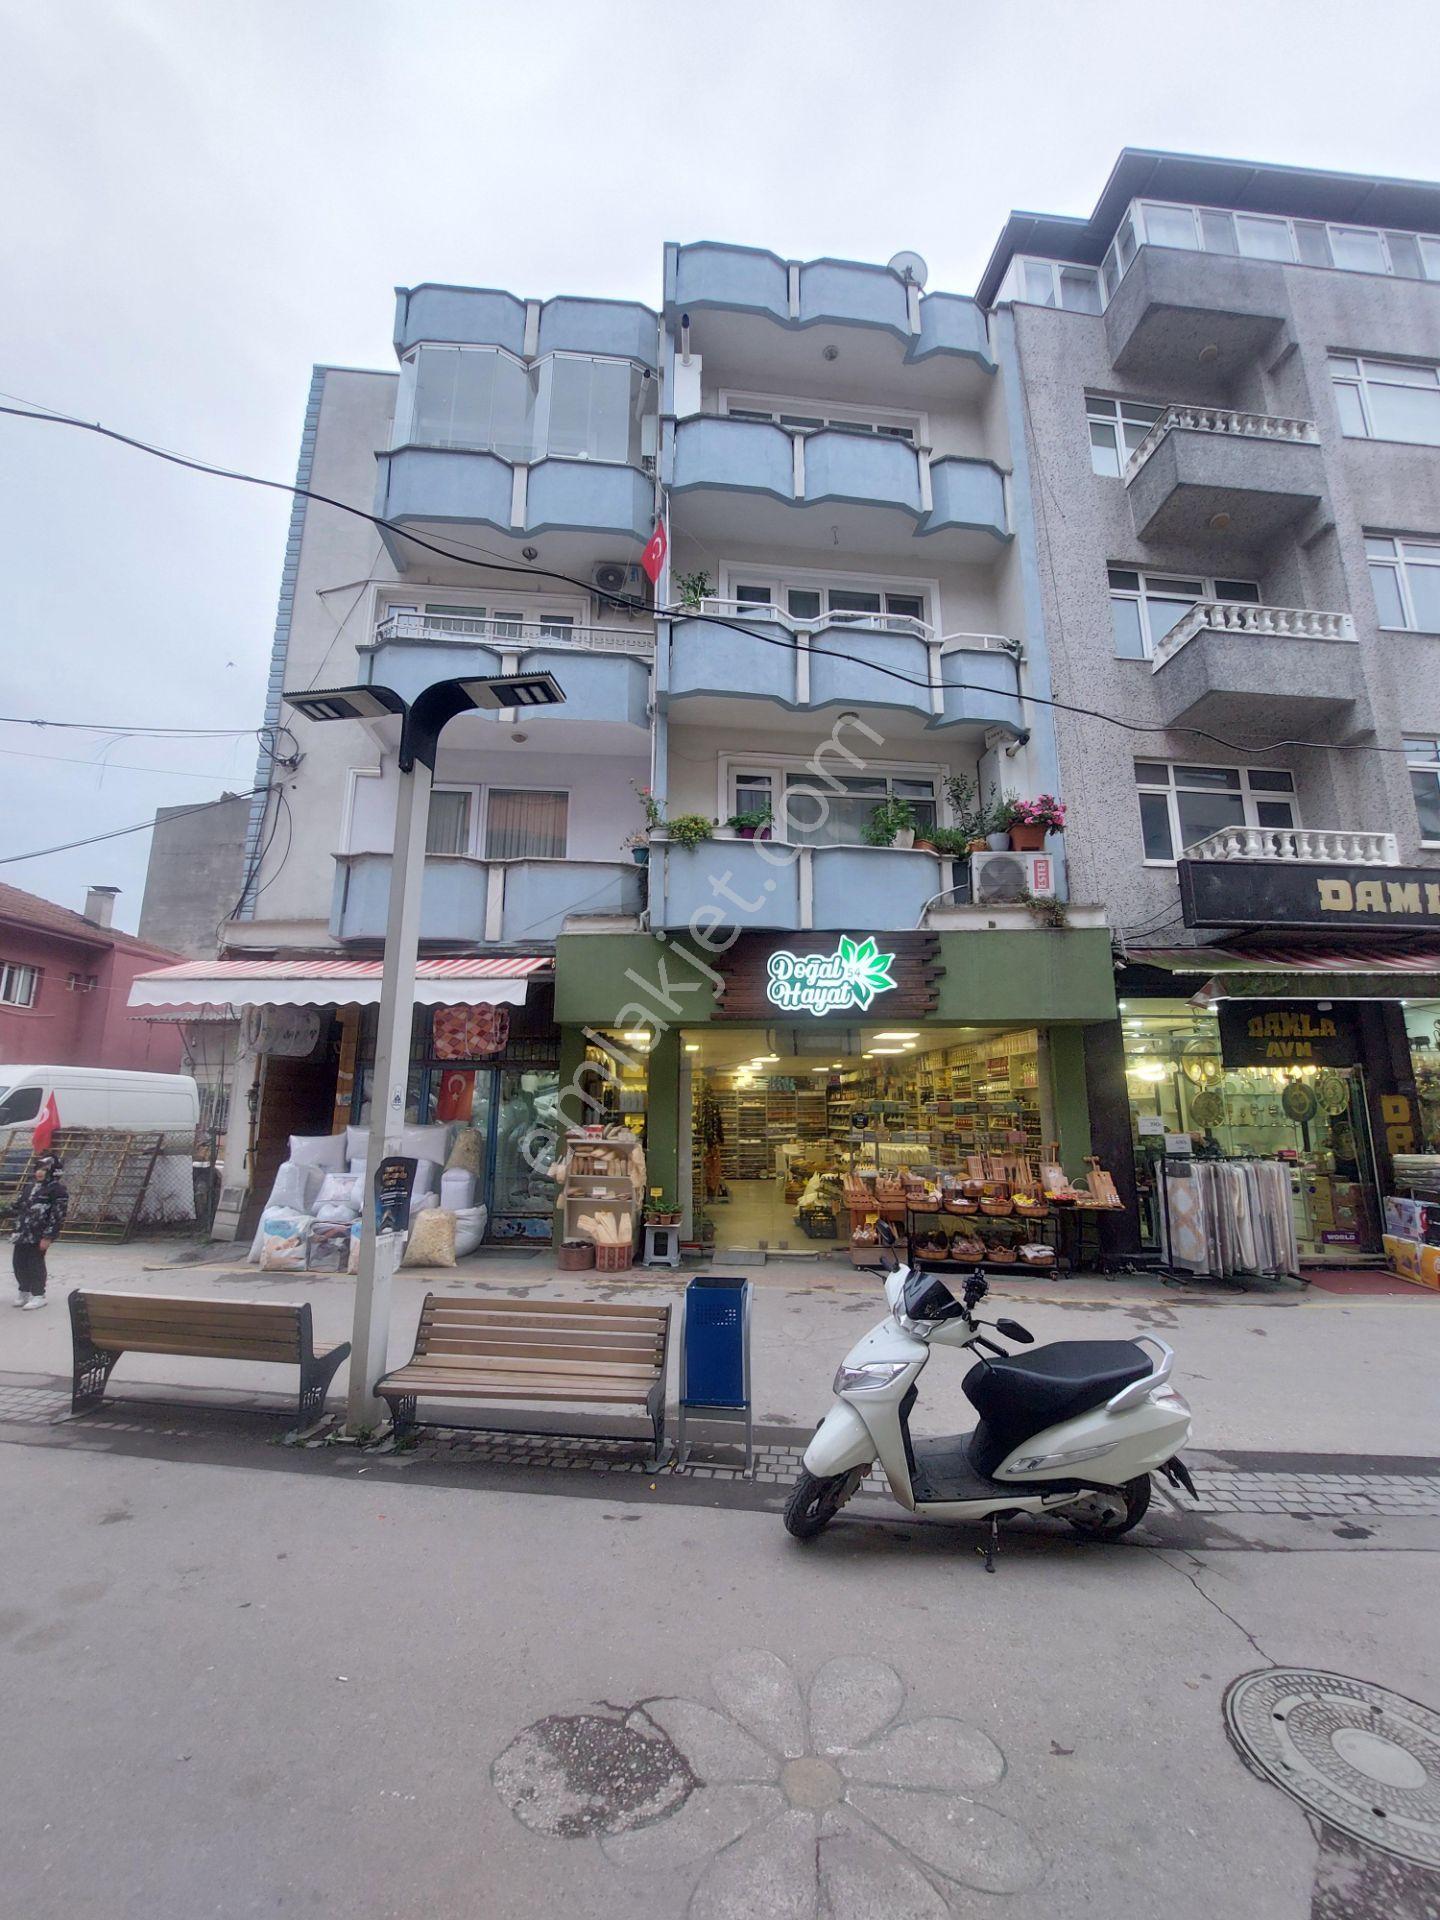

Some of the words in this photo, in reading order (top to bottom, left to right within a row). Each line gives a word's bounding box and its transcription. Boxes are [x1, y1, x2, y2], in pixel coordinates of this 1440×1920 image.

[771, 954, 843, 985] Doğal
[771, 980, 853, 1010] Hayat
[1247, 1012, 1336, 1038] DAMLA
[1266, 1041, 1312, 1057] AVM
